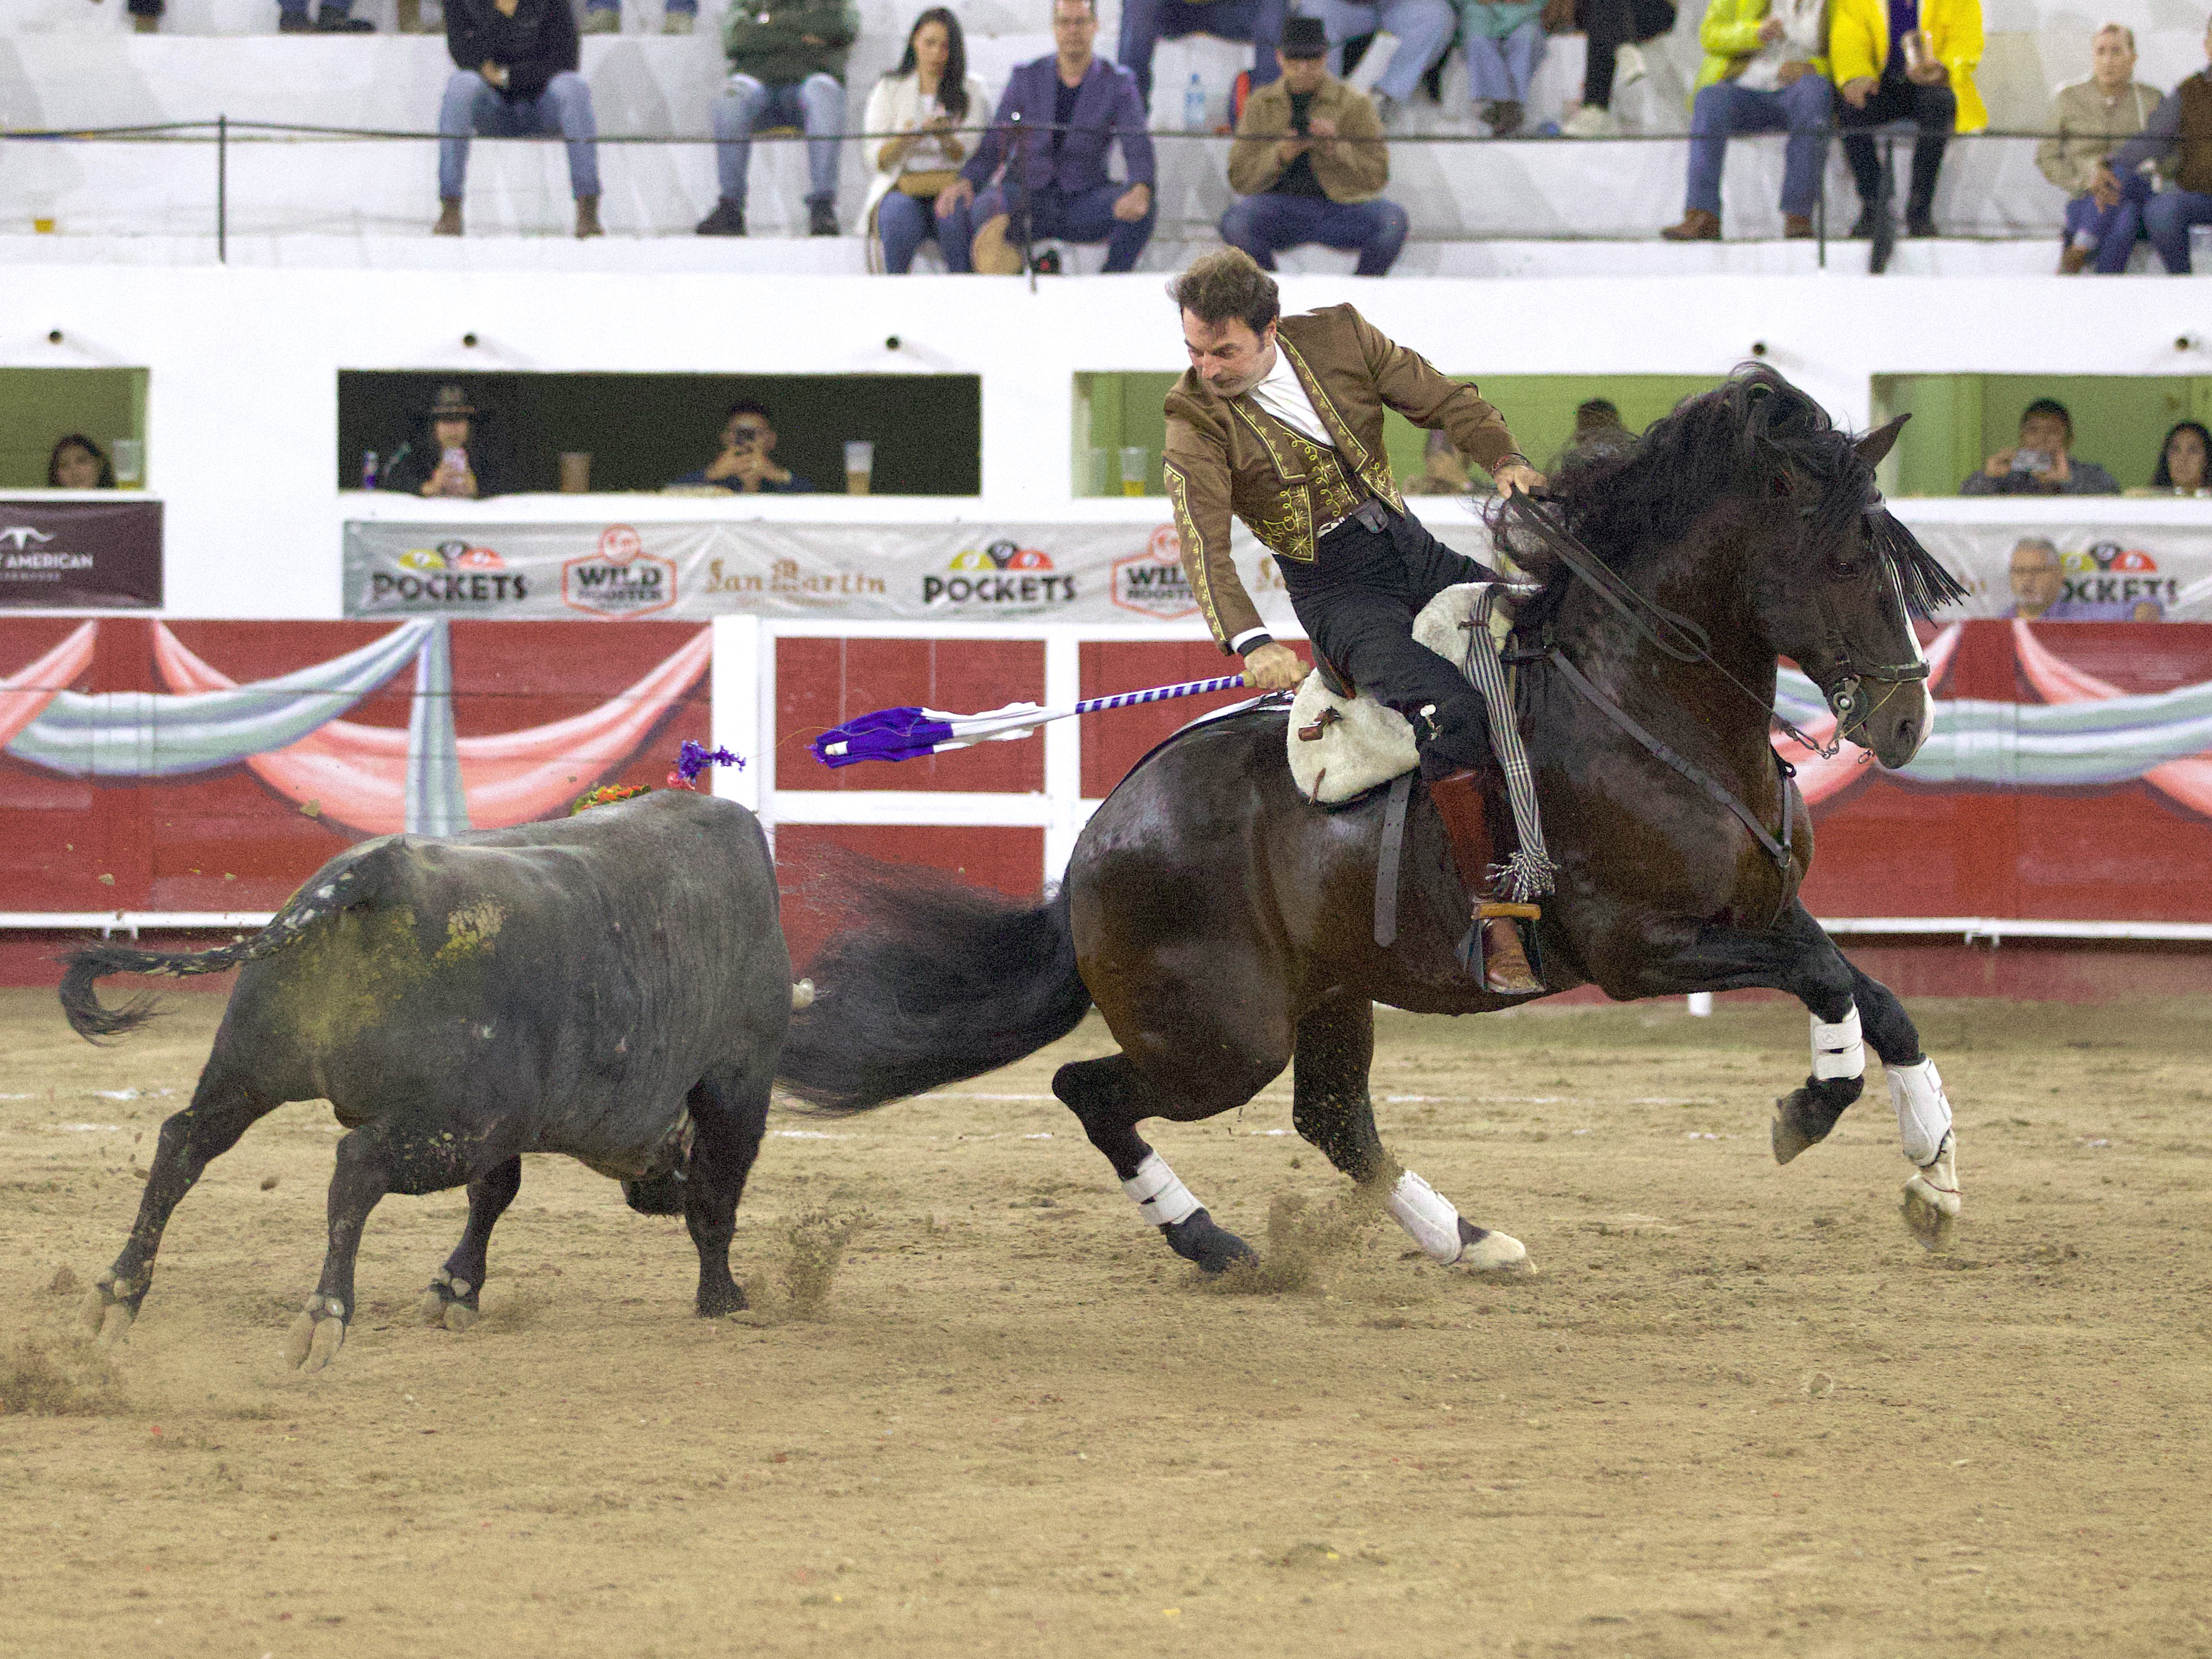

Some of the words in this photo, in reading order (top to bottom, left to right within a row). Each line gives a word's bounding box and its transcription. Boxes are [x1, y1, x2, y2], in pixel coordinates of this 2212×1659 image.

[6, 553, 94, 569] AMERICAN
[576, 566, 663, 586] WILD
[1126, 566, 1189, 585] WIL
[371, 571, 528, 602] POCKETS
[923, 573, 1077, 604] POCKETS
